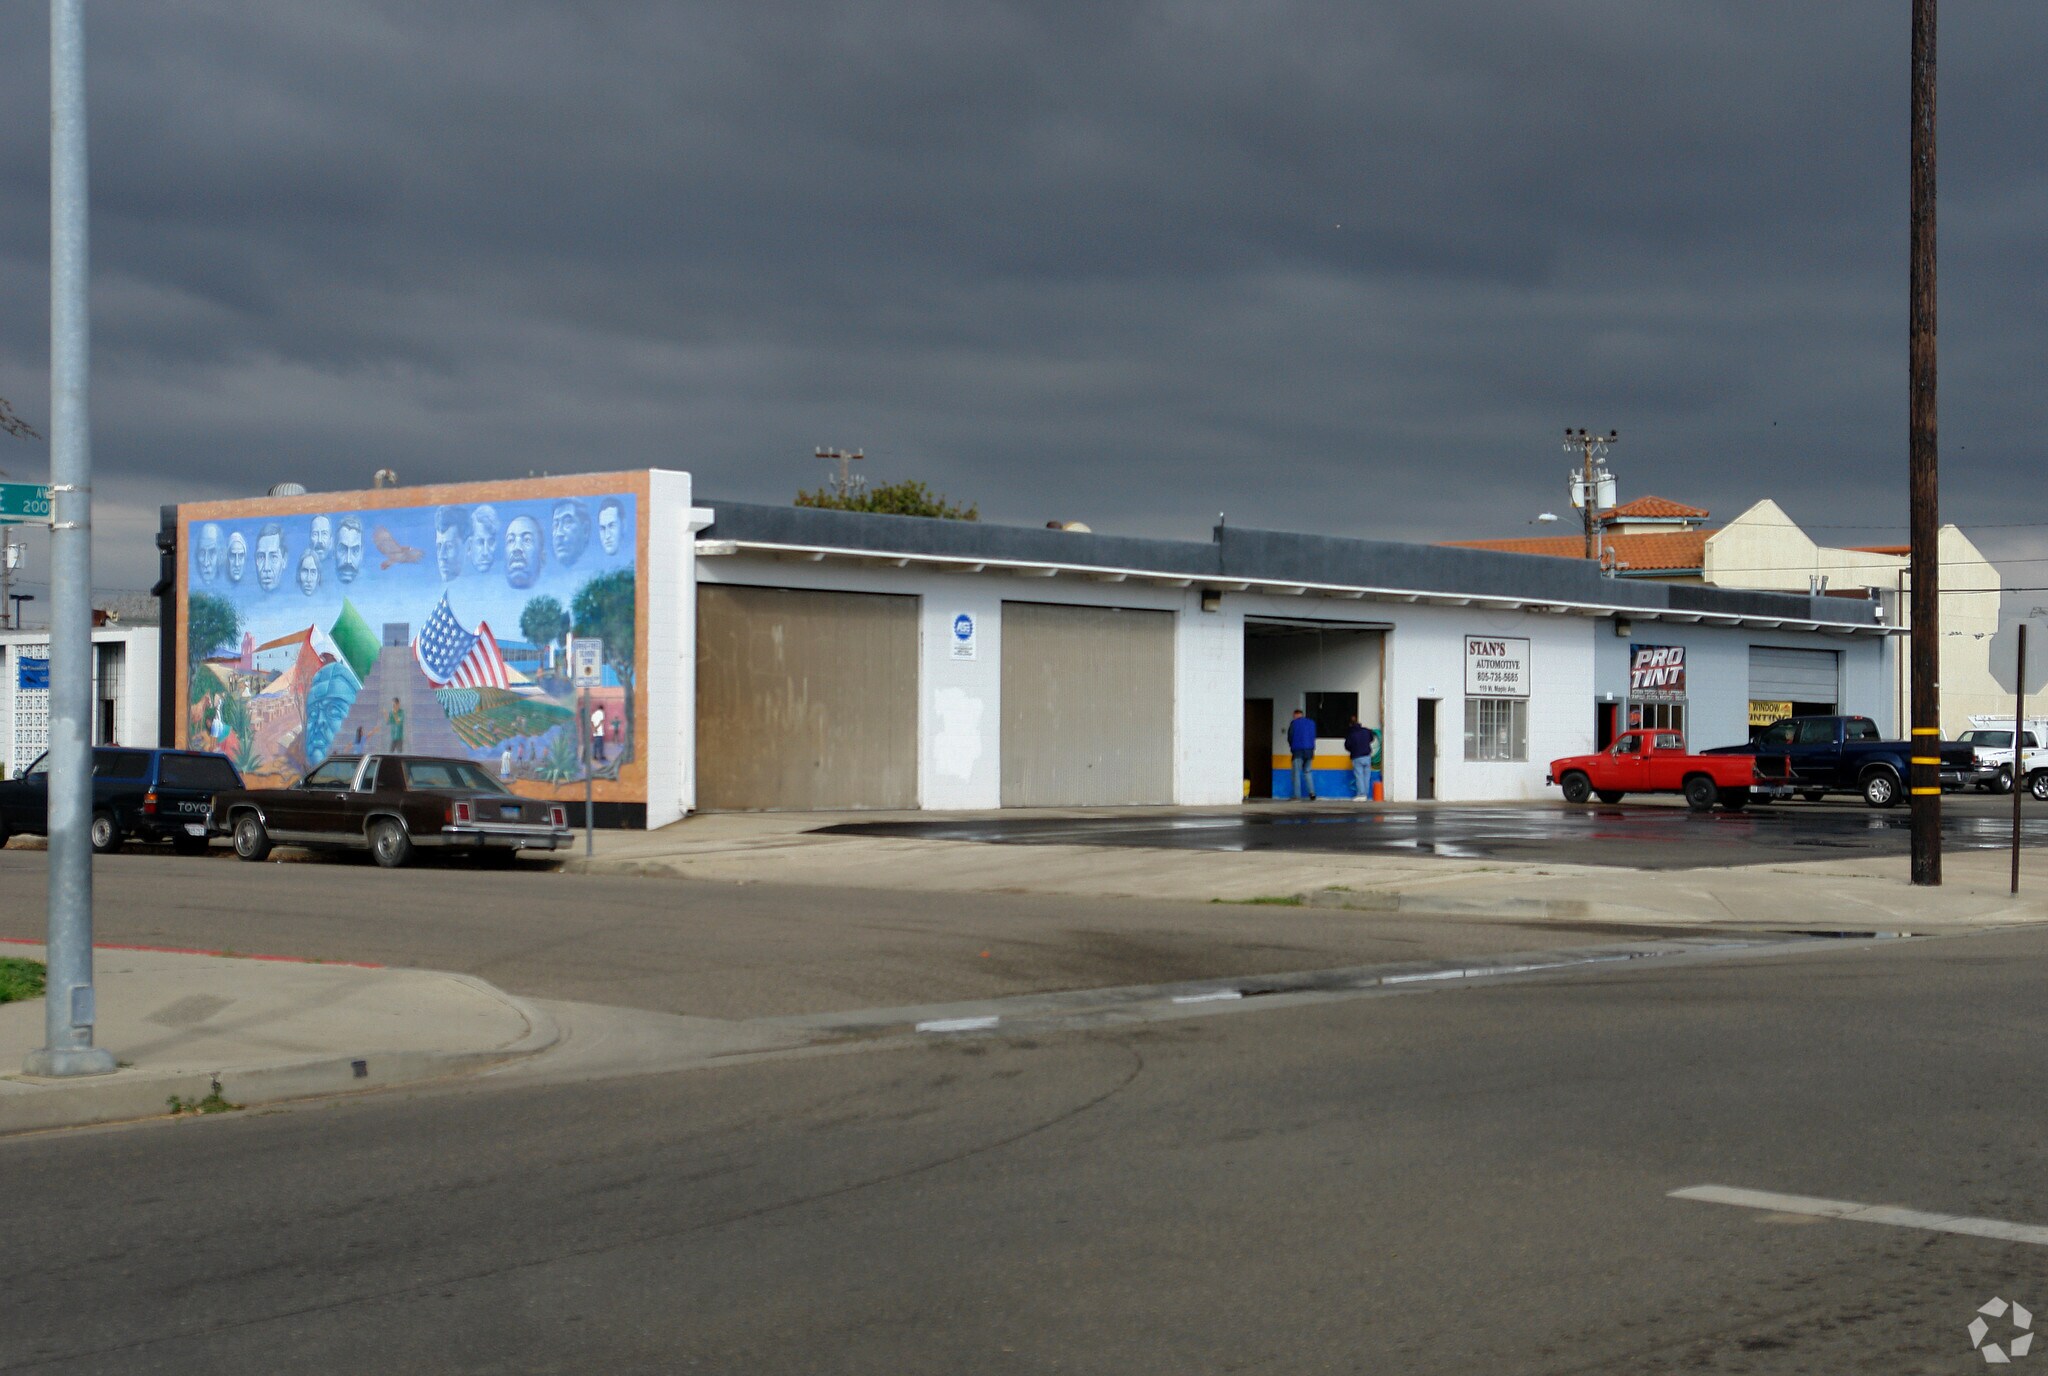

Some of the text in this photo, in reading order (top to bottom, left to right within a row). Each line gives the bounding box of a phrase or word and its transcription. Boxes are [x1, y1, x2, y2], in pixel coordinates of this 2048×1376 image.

[23, 500, 48, 513] 200
[1469, 641, 1506, 657] STAN'S
[1476, 659, 1521, 670] AUTOMOTIVE
[1635, 647, 1684, 669] PRO
[1632, 666, 1684, 689] TINT
[1753, 702, 1780, 713] WINDOW
[178, 802, 213, 813] TOYOT
